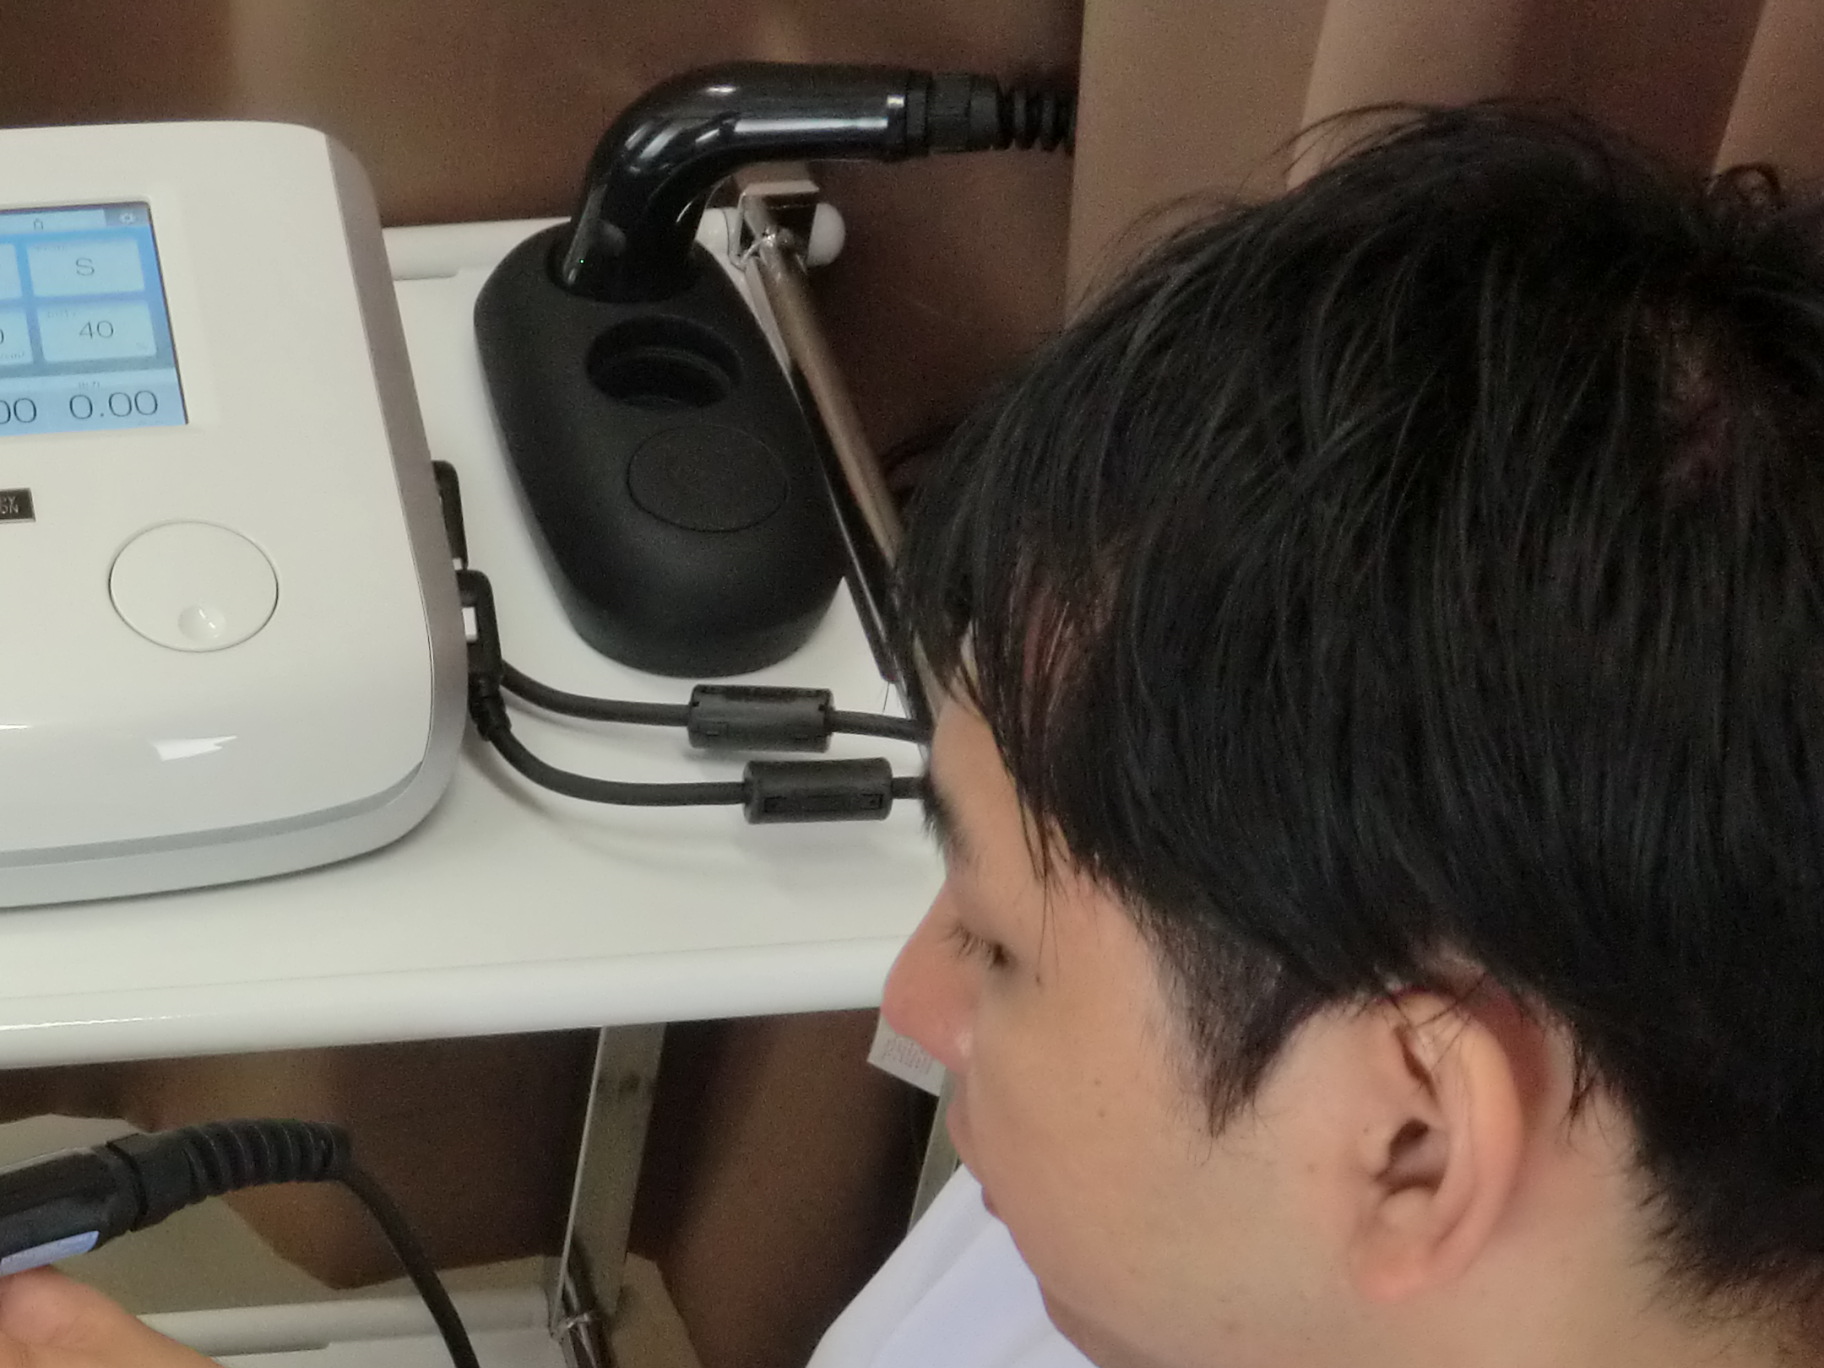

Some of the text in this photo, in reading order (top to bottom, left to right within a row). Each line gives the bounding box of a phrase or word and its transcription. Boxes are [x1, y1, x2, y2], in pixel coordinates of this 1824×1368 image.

[75, 257, 95, 277] S
[79, 320, 114, 339] 40
[69, 390, 158, 420] 0.00
